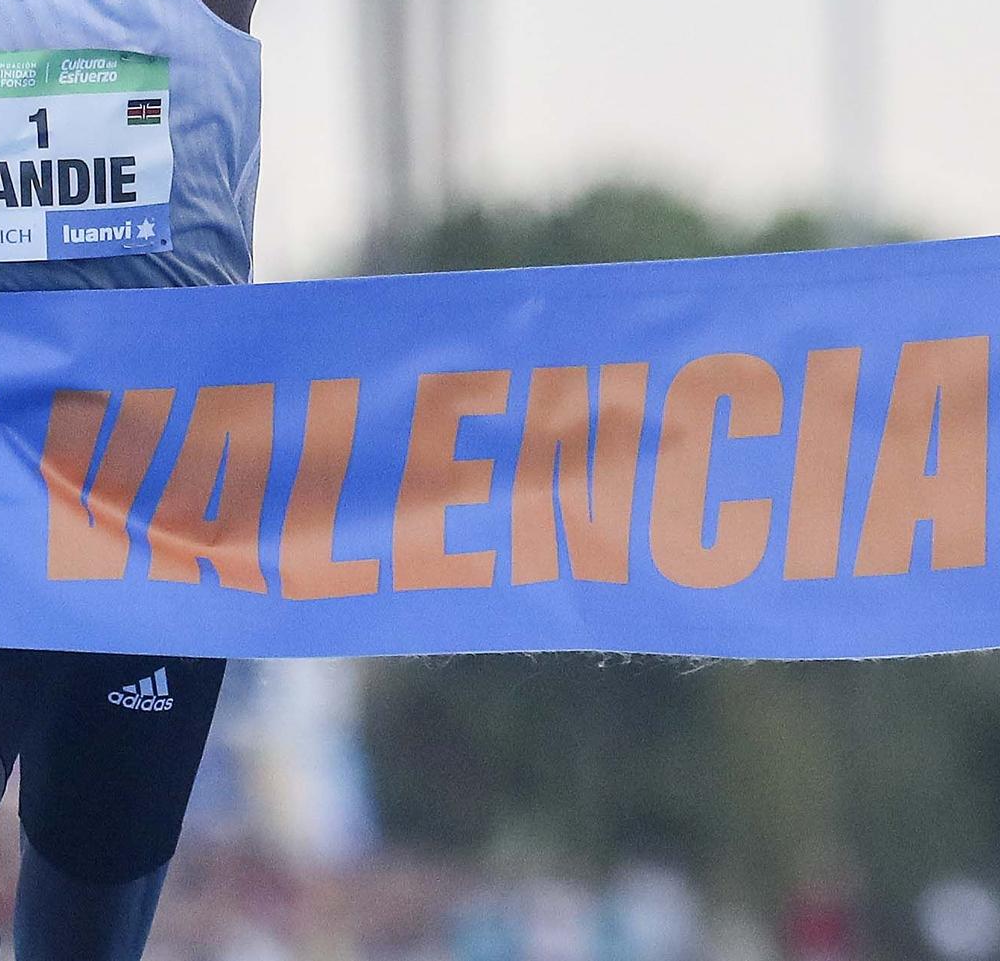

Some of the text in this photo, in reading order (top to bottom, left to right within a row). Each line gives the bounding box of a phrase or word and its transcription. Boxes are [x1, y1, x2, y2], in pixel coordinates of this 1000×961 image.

[61, 58, 105, 71] Cultura
[58, 70, 118, 84] Esfuerzo
[28, 108, 49, 149] 1
[63, 221, 132, 243] luanvi
[40, 335, 990, 600] VALENCIA
[107, 691, 174, 711] adidas
